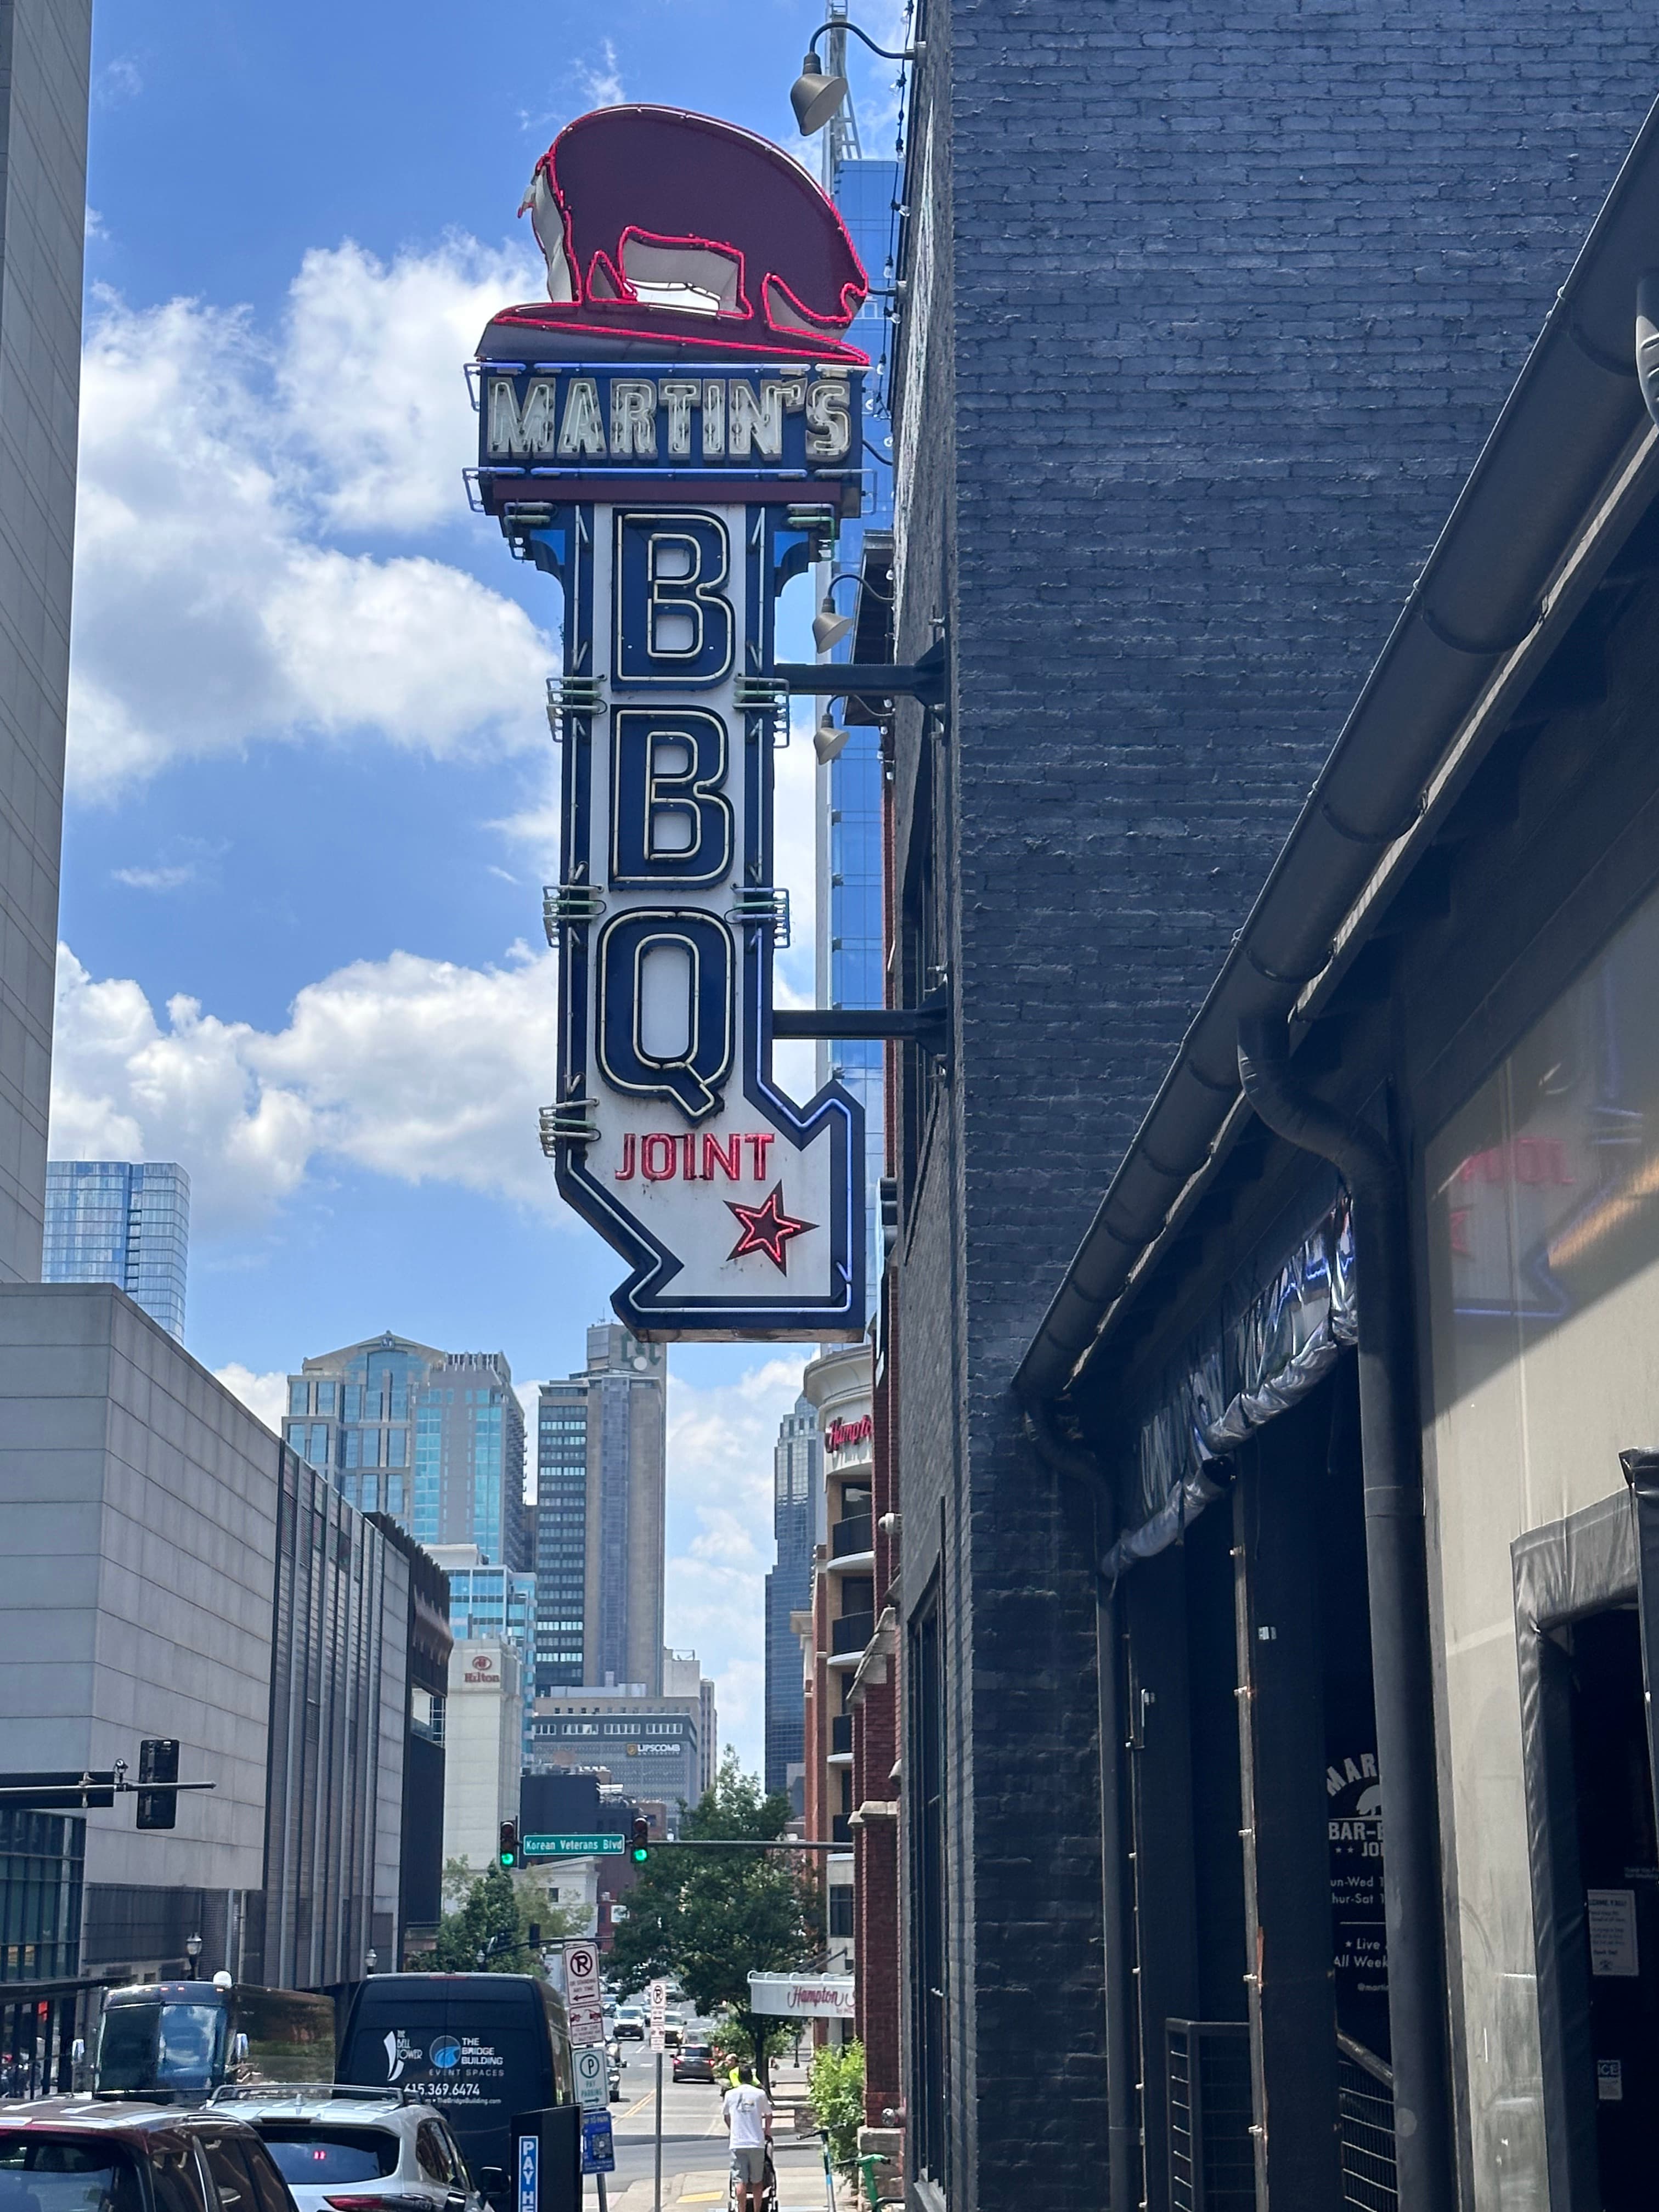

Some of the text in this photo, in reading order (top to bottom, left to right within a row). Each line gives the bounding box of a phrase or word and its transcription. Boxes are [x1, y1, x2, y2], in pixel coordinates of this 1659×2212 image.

[487, 377, 853, 462] MARTIN'S
[615, 1133, 775, 1181] JOINT
[465, 1672, 500, 1683] Hilton
[526, 1839, 623, 1850] Korean Veterans Blvd
[1356, 1938, 1380, 1950] Live
[1333, 1954, 1350, 1967] All
[787, 1985, 844, 2008] Hampton
[397, 2039, 410, 2049] BELL
[461, 2038, 480, 2046] THE
[397, 2049, 422, 2060] TOWER
[461, 2047, 495, 2056] BRIDGE
[461, 2057, 504, 2066] BUILDING
[428, 2068, 505, 2076] EVENT SPACES
[581, 2088, 602, 2097] PARKING
[522, 2141, 535, 2185] PAY
